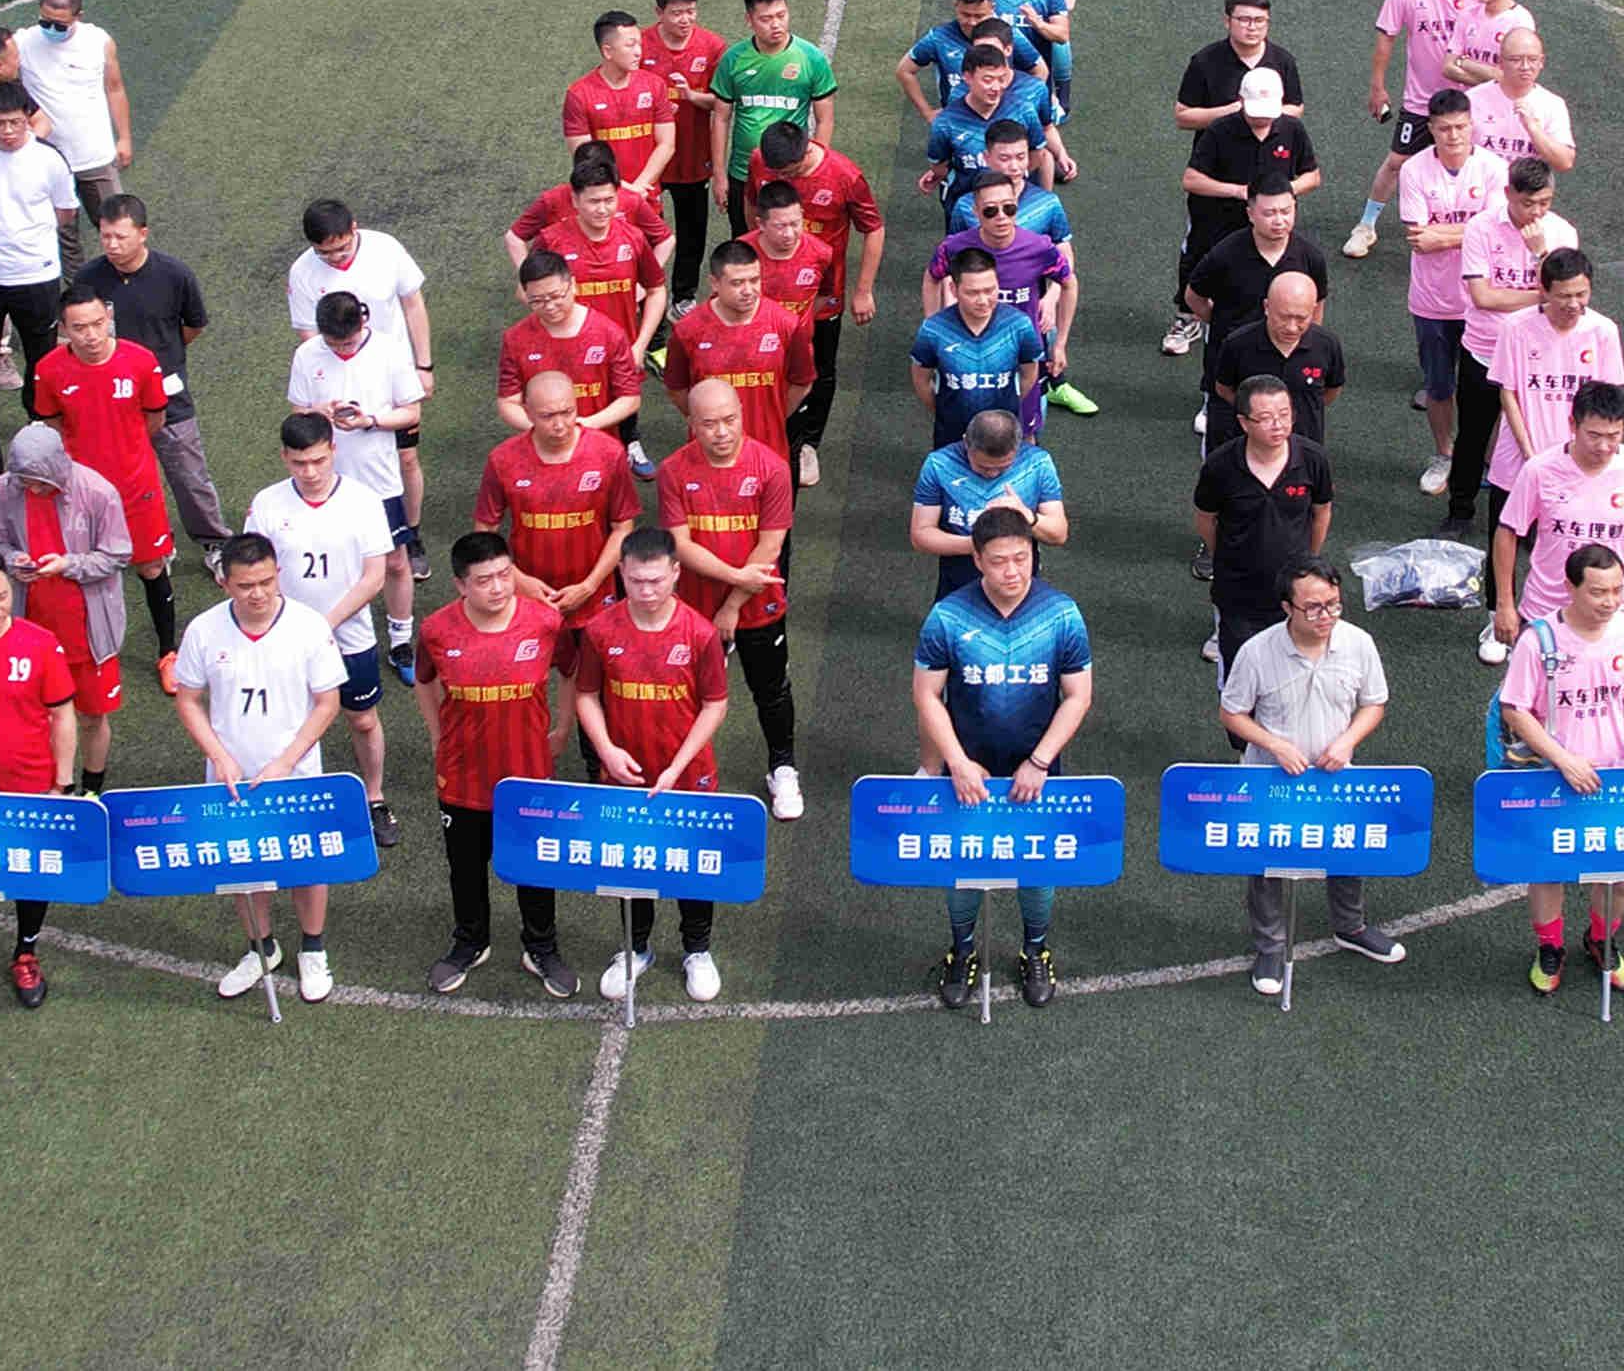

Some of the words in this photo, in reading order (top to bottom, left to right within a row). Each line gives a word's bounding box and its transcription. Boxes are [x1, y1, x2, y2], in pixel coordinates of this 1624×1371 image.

[112, 378, 133, 398] 18
[303, 552, 328, 579] 21
[7, 656, 32, 682] 19
[963, 663, 1050, 685] 盐都工运
[241, 688, 268, 717] 71
[1268, 785, 1291, 800] 2022
[897, 833, 1078, 860] 自贡市总工会
[1205, 821, 1388, 849] 自贡市自规局
[134, 831, 345, 870] 自贡市委组织部
[536, 836, 722, 875] 自贡城投集团
